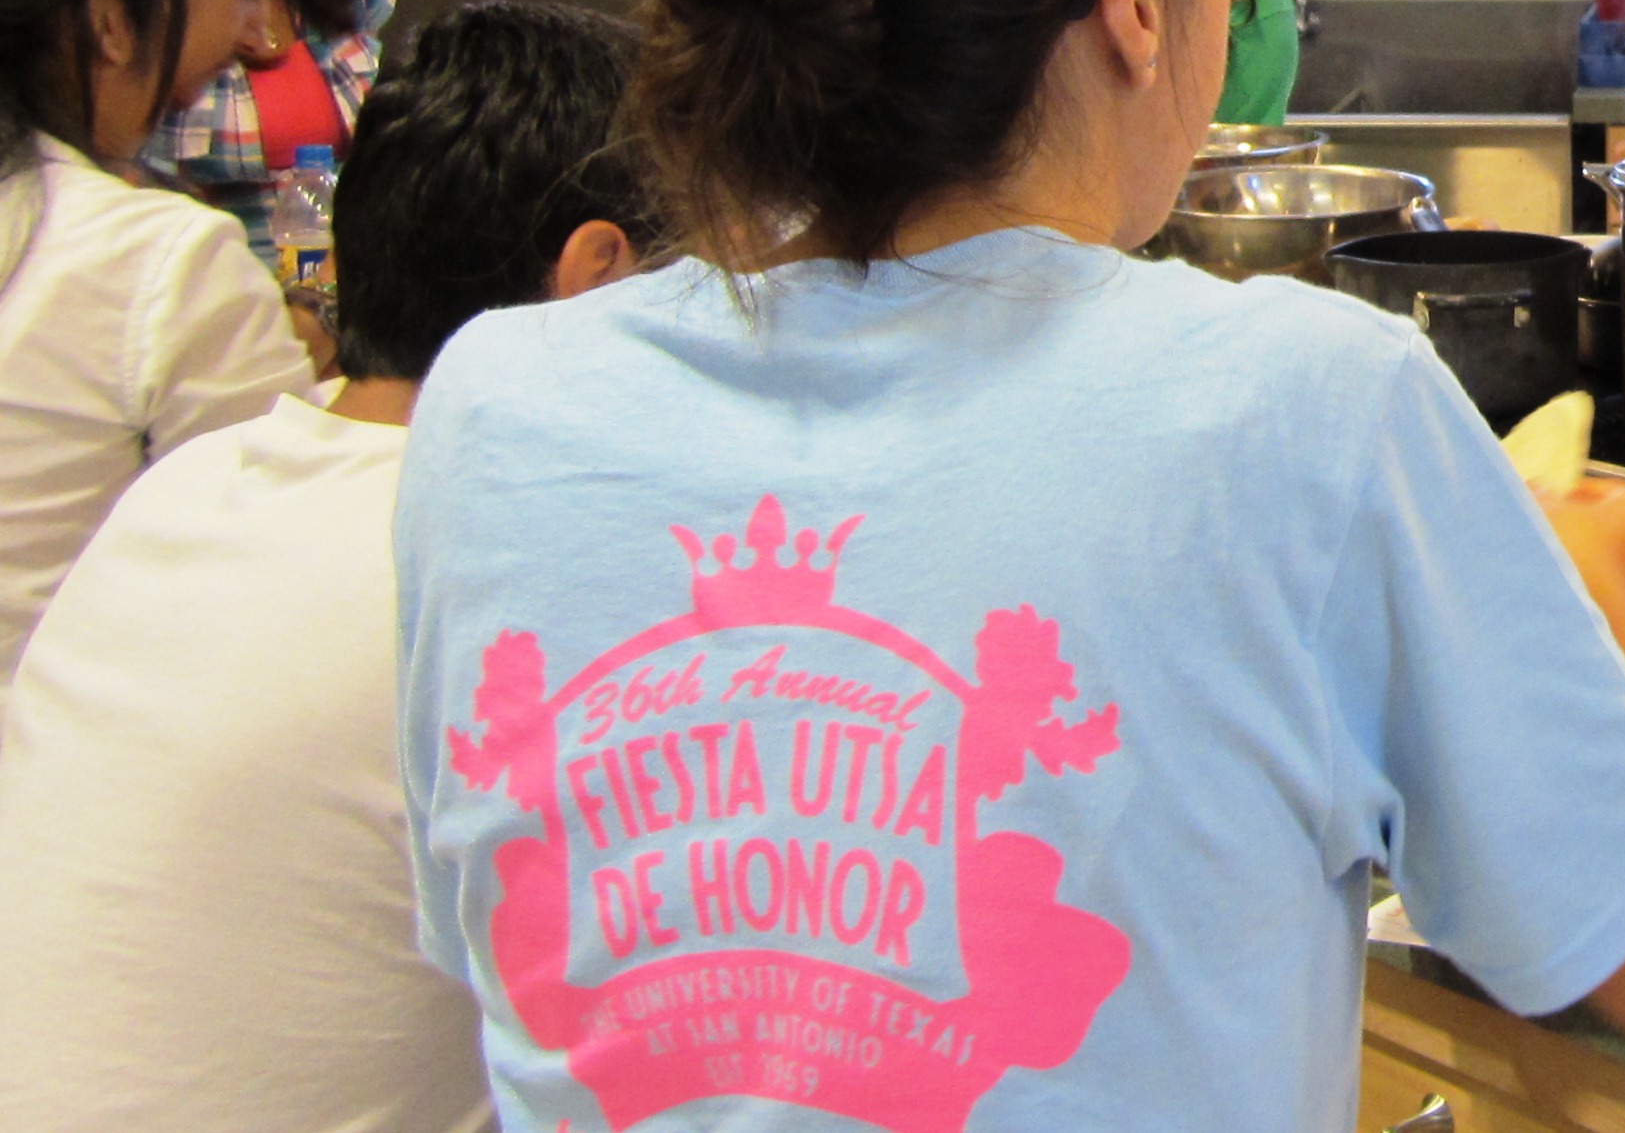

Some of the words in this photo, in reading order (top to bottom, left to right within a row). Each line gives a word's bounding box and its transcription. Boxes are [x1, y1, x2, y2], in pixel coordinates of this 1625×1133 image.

[579, 652, 707, 745] 36th
[720, 644, 933, 732] Annual
[564, 720, 768, 850] FIESTA
[789, 719, 947, 846] UTSA
[590, 851, 681, 960] DE
[688, 837, 926, 968] HONOR
[624, 964, 799, 1021] UNIVERSITY
[811, 977, 853, 1016] OF
[867, 991, 977, 1066] TEXAS
[645, 1022, 680, 1056] AT
[684, 1012, 741, 1045] SAN
[756, 1012, 884, 1068] ANTONIO
[761, 1054, 820, 1096] 1969
